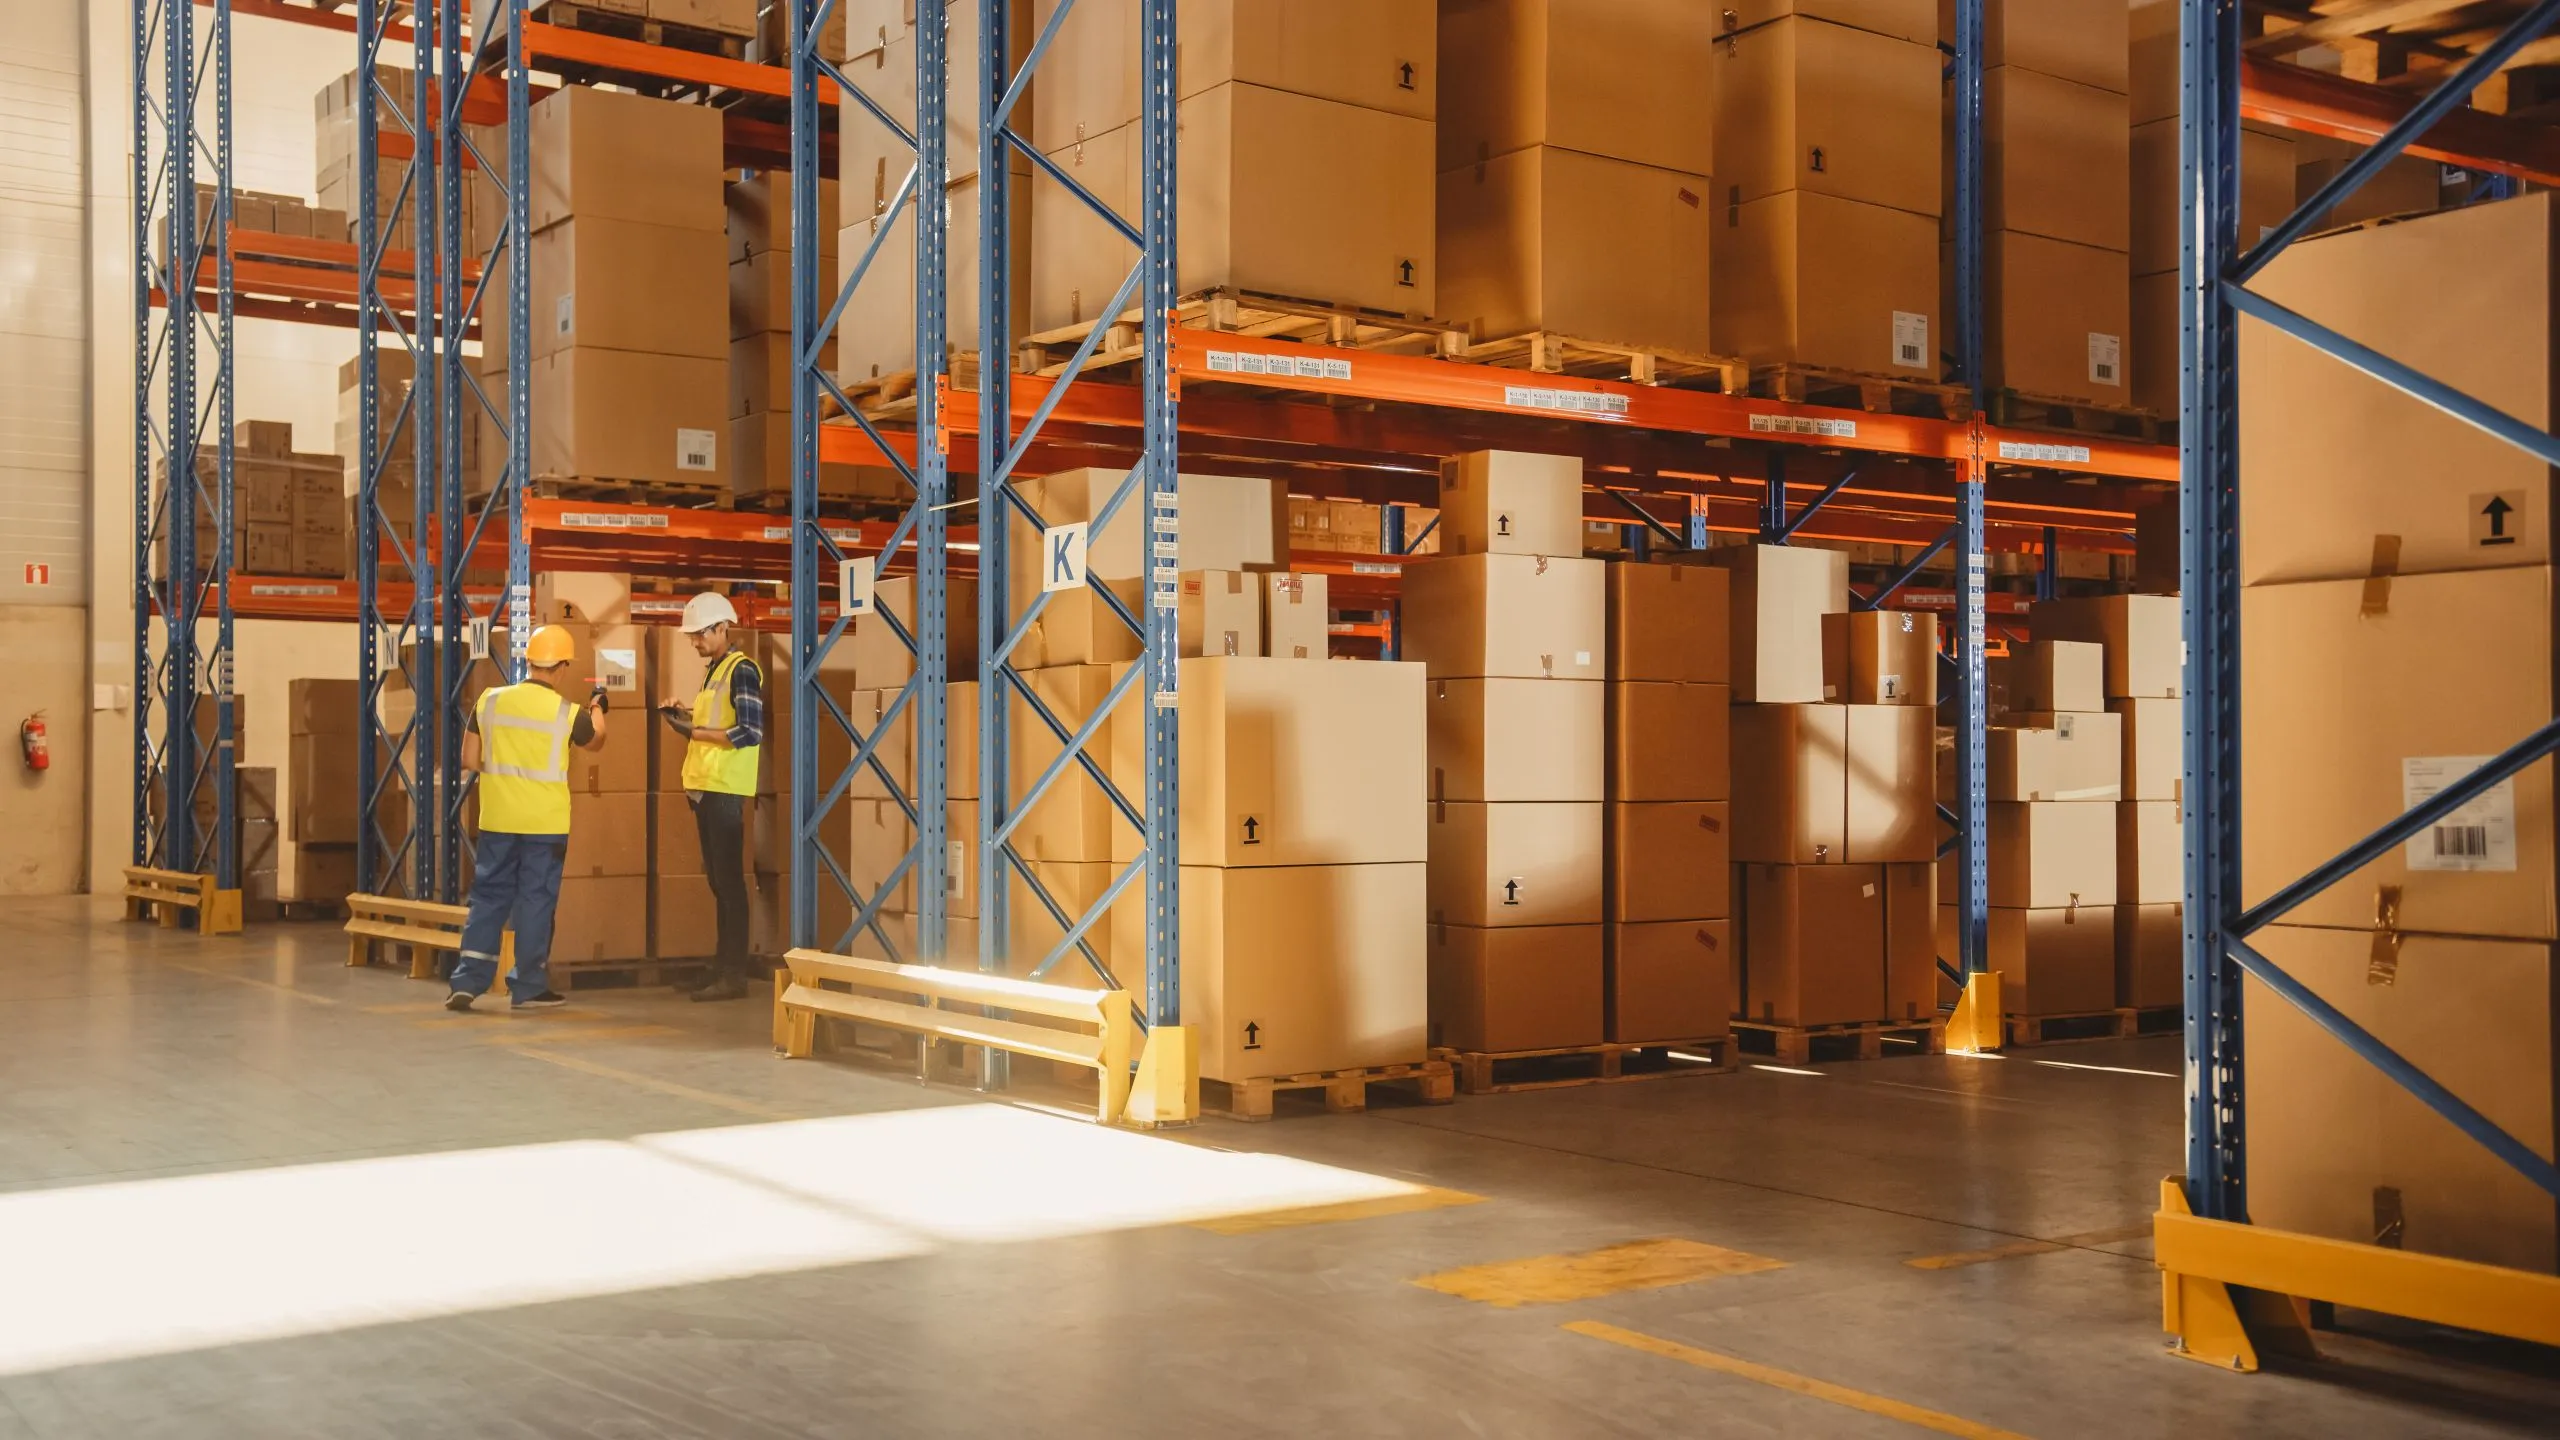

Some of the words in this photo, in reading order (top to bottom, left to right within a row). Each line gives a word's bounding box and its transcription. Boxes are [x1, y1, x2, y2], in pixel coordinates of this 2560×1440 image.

[1053, 532, 1074, 582] K
[850, 567, 863, 608] L
[386, 637, 394, 664] N
[473, 623, 484, 654] M
